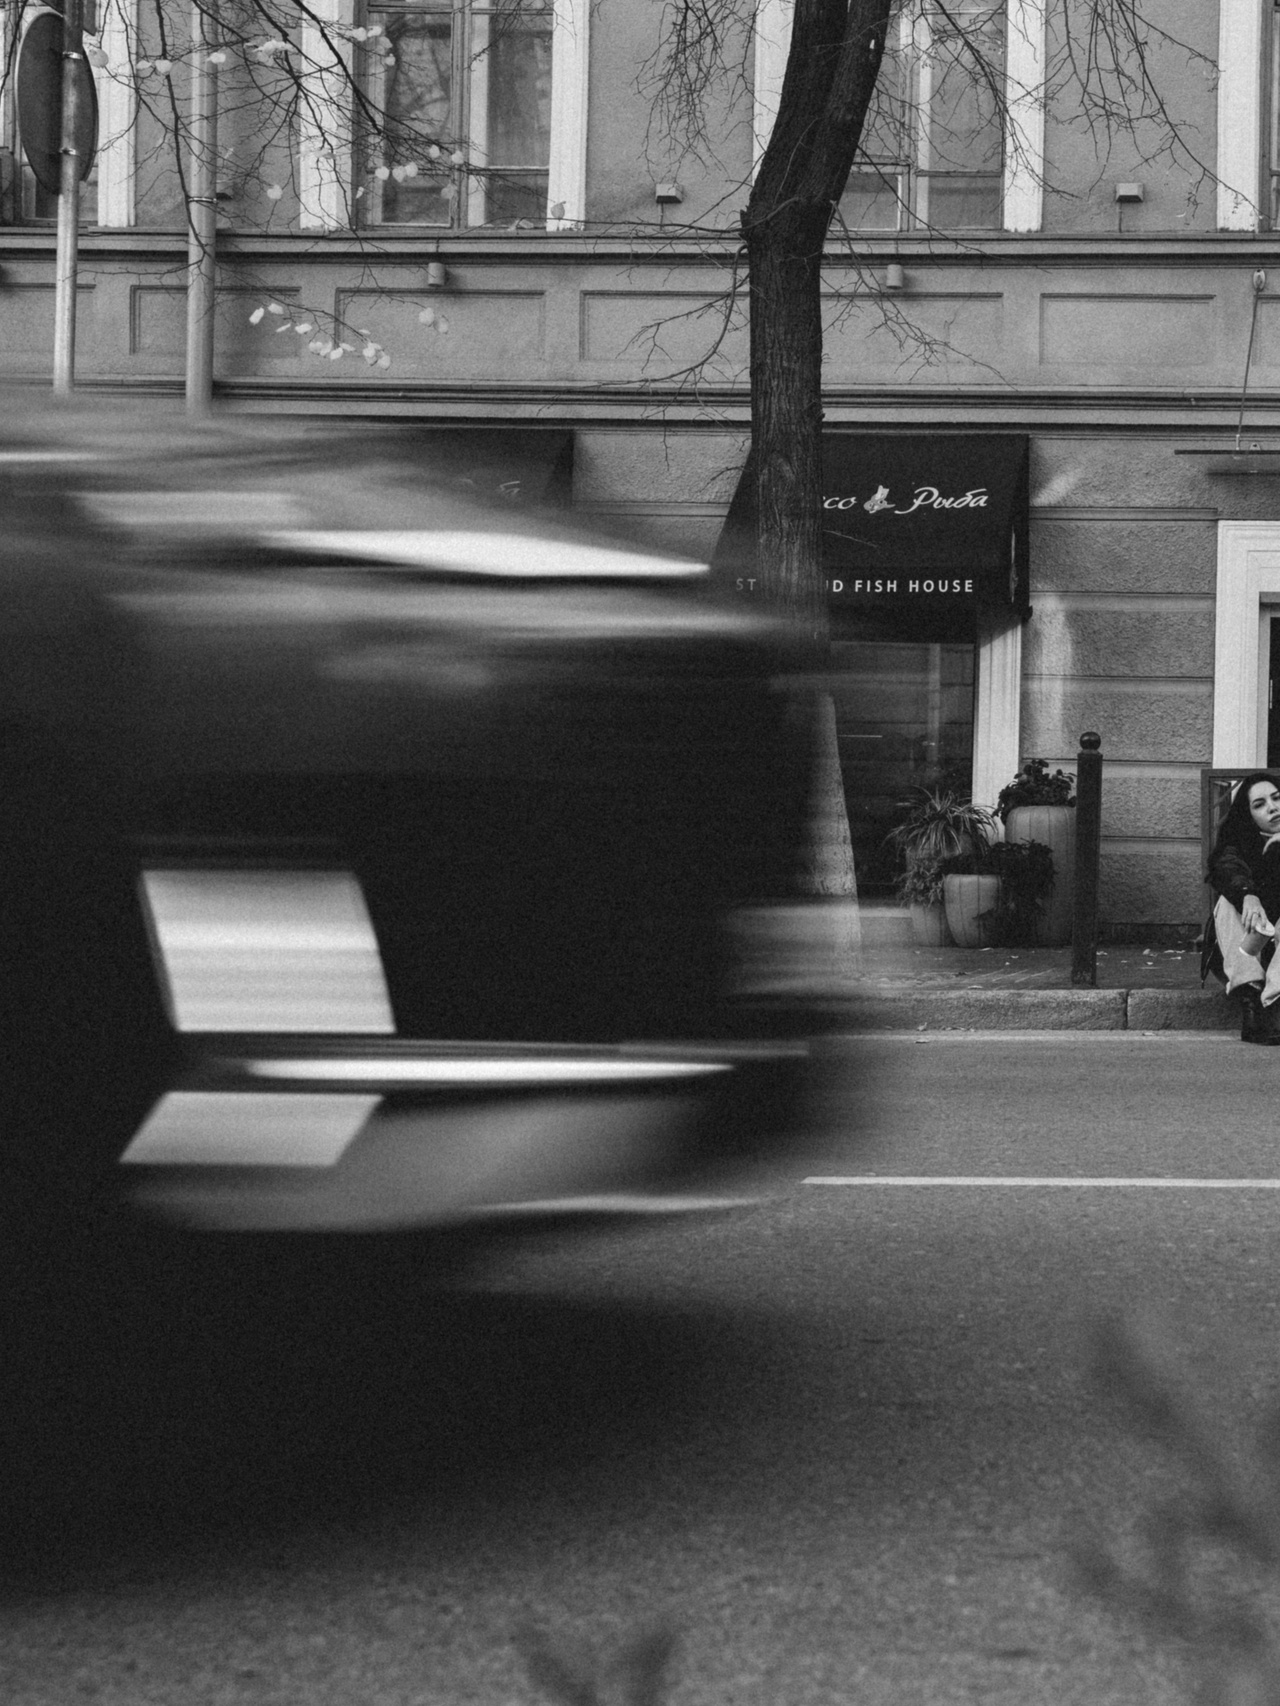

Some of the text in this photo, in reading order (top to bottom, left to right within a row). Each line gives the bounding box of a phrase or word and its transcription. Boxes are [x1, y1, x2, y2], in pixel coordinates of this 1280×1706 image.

[823, 486, 989, 514] со Рыба
[854, 579, 898, 593] FISH
[909, 579, 974, 593] HOUSE
